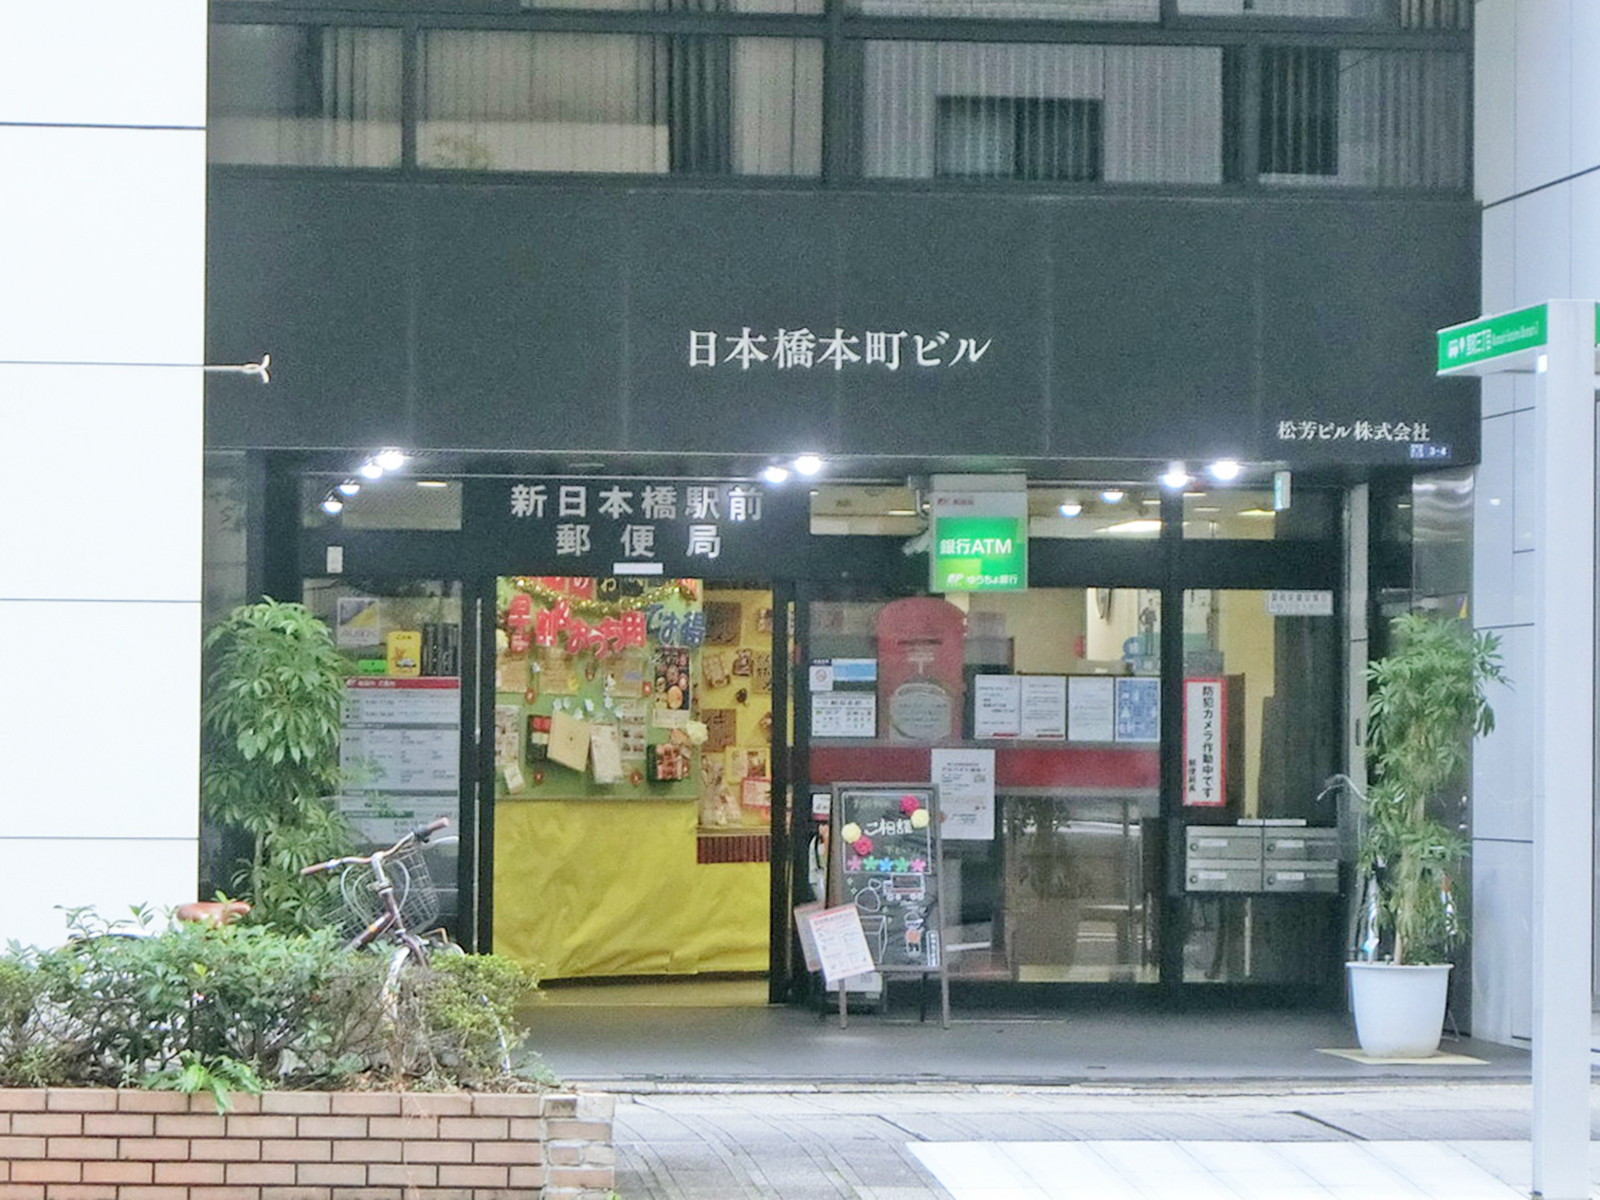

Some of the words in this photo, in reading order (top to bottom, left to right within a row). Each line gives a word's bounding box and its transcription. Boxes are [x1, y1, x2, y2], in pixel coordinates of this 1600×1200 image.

[689, 327, 992, 371] 日本橋本町ビル
[1278, 421, 1431, 441] 松芳ビル株式会社
[511, 484, 764, 521] 新日本橋駅前
[556, 524, 721, 559] 郵便局
[940, 538, 1012, 555] 銀行ATM
[1202, 686, 1215, 798] 防犯カメラ作動中です
